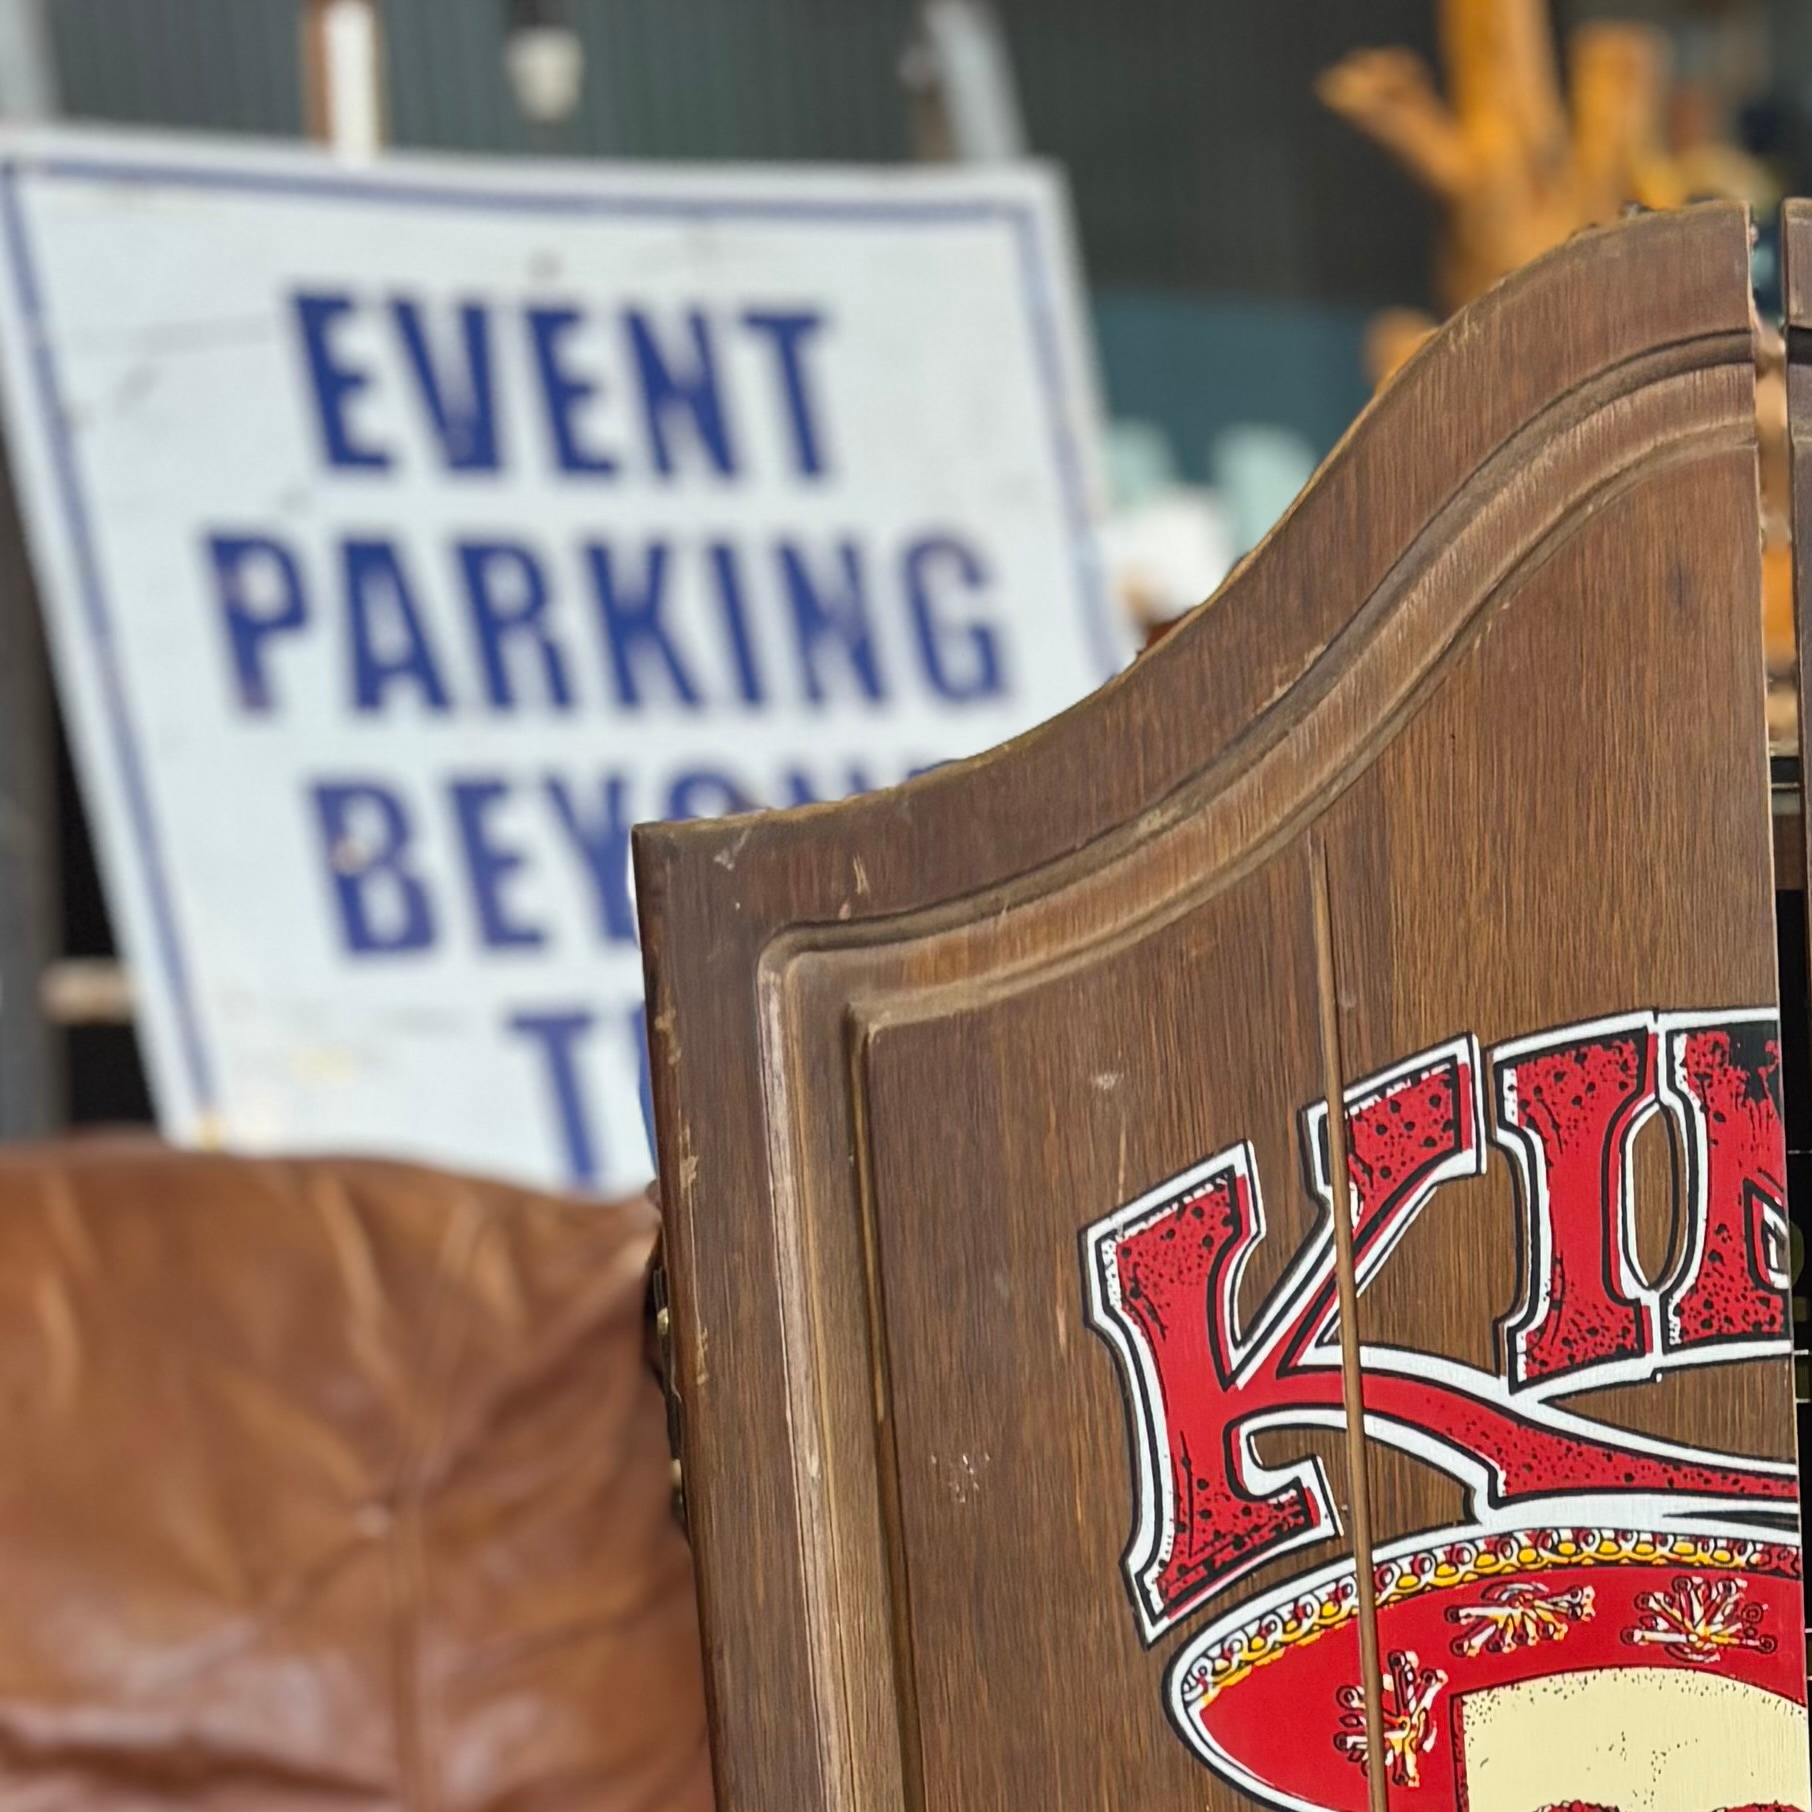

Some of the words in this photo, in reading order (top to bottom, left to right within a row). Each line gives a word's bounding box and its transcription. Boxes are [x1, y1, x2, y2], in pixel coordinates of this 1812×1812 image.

[288, 289, 833, 483] EVENT
[202, 530, 1015, 718] PARKING
[307, 757, 965, 958] BEY
